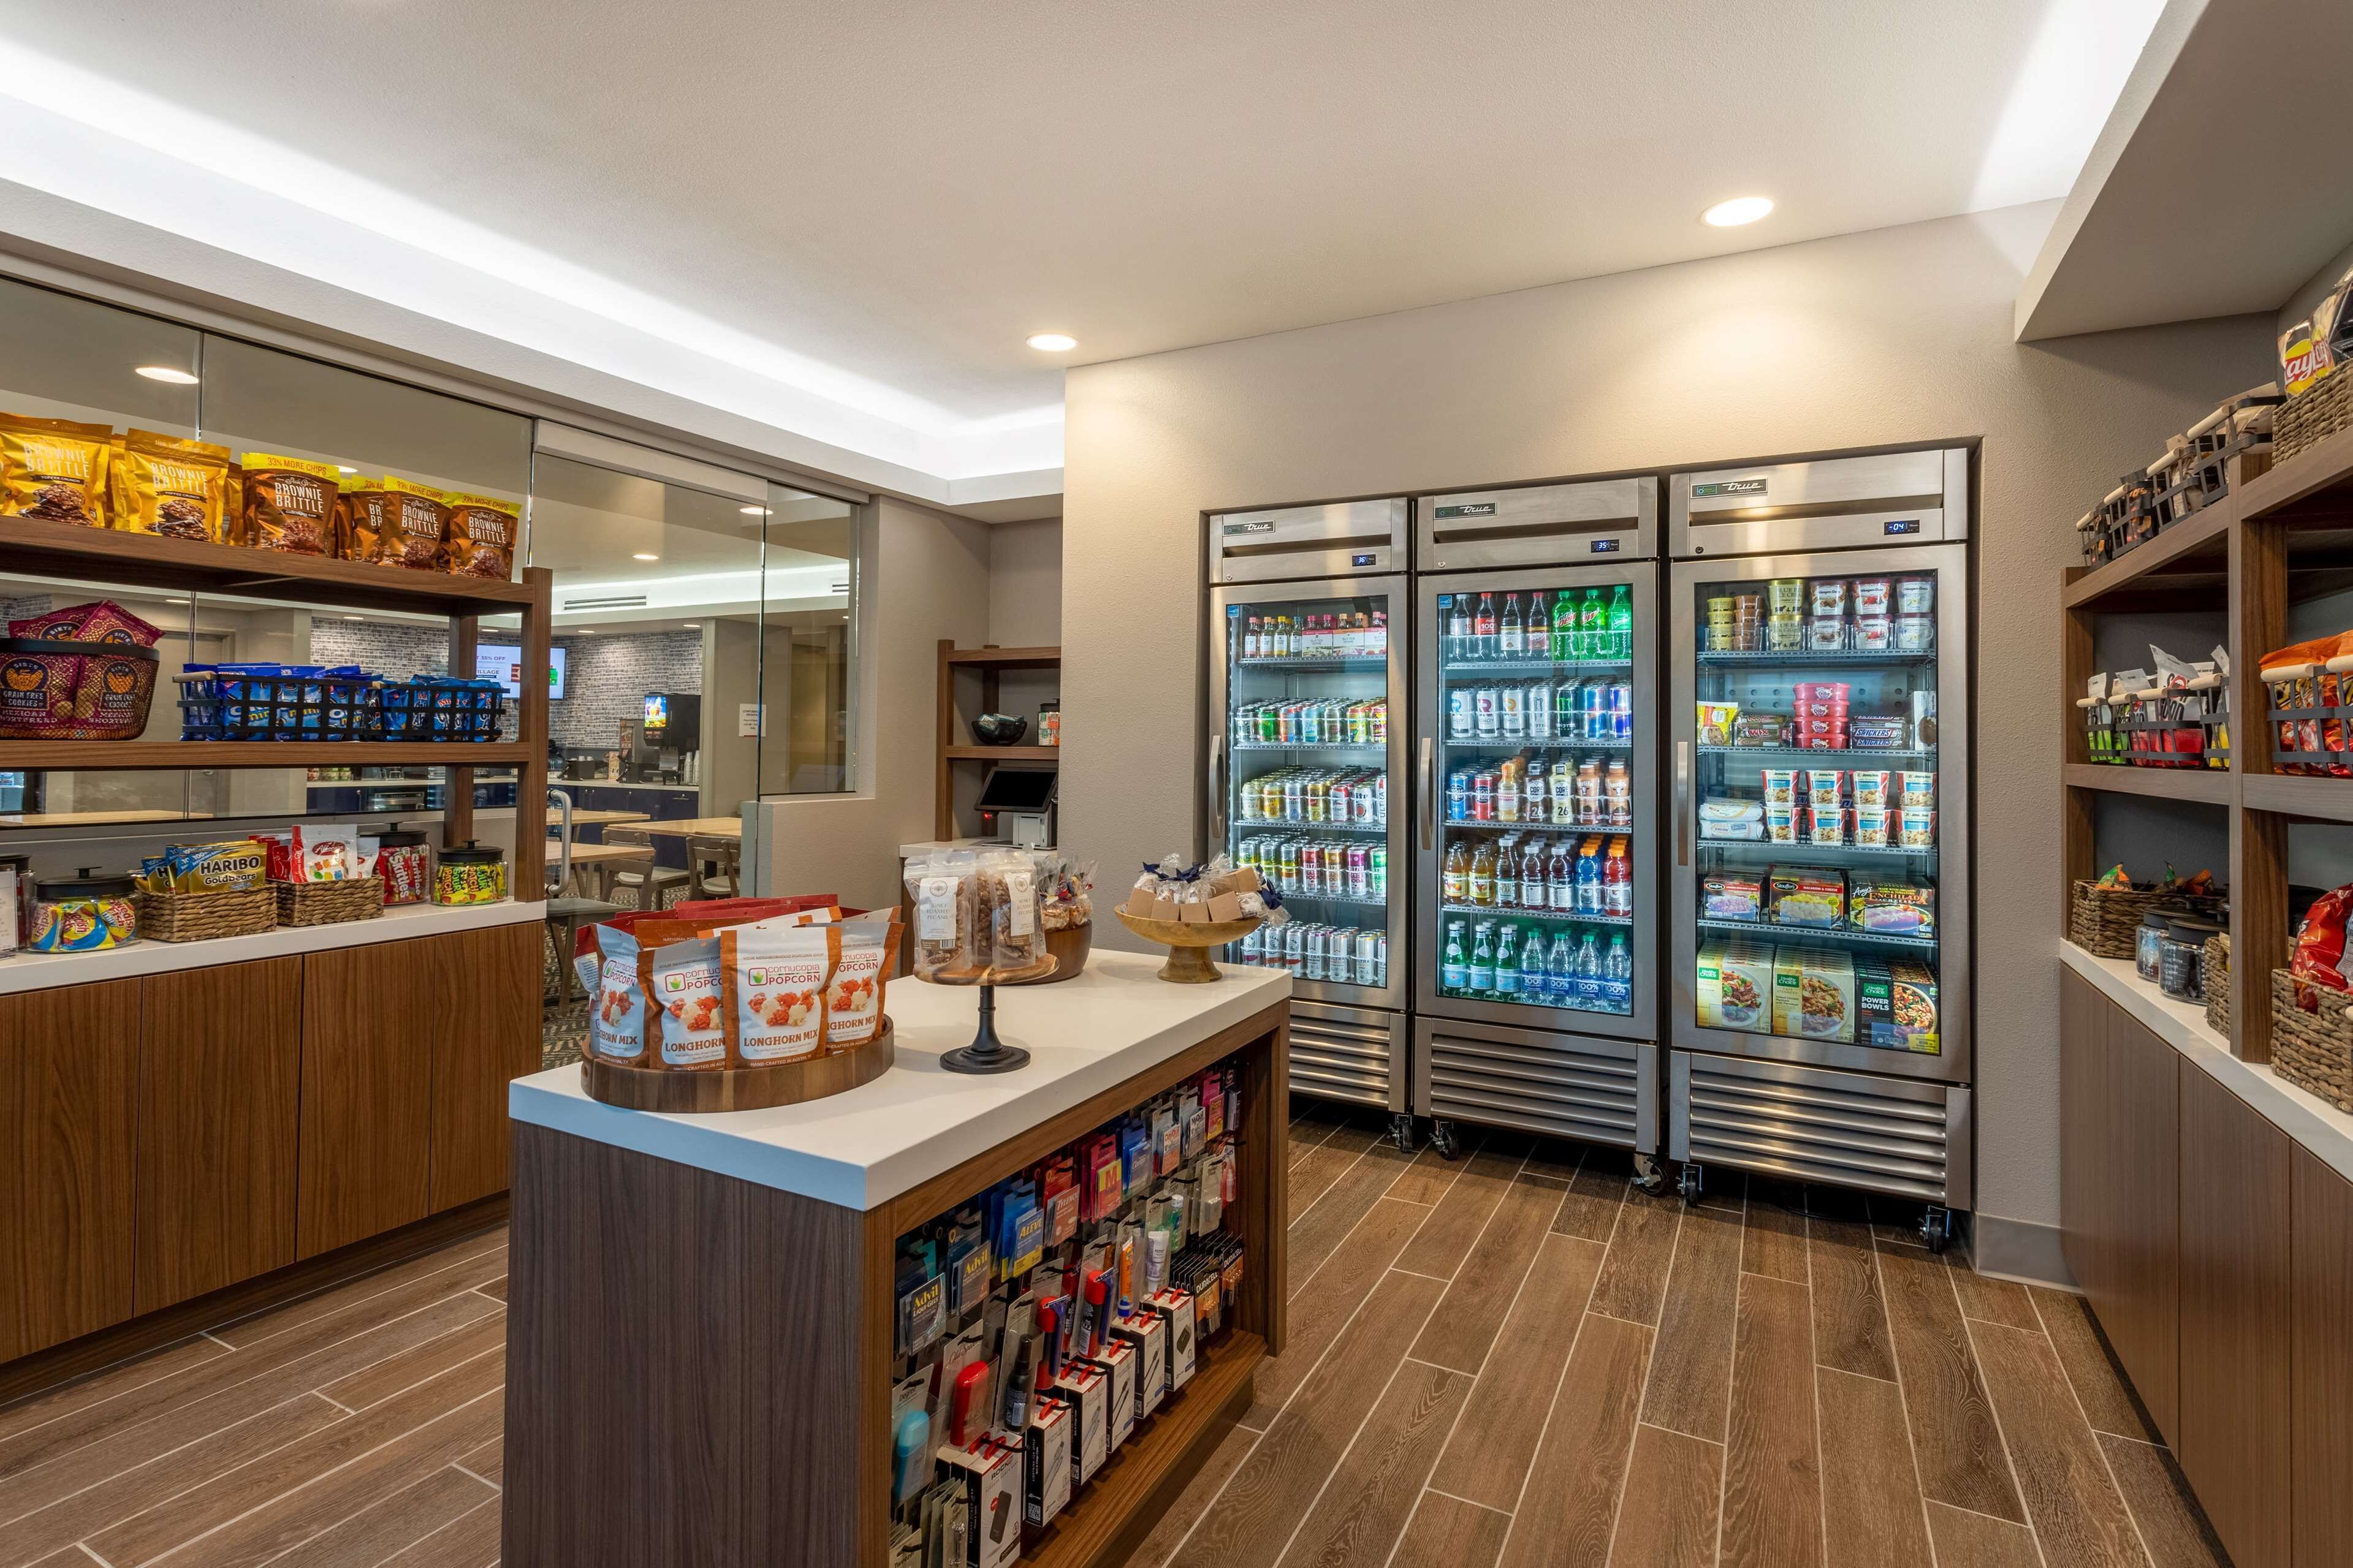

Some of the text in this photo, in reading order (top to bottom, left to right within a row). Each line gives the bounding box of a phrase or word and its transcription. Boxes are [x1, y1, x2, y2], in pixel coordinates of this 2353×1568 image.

[25, 442, 89, 464] BROWNIE
[26, 457, 90, 478] BRITTLE
[151, 462, 207, 482] BROWNIE
[267, 456, 327, 475] 33% MORE CHIPS
[152, 475, 207, 495] BRITTLE
[275, 482, 323, 501] BROWNIE
[409, 484, 425, 494] MORE
[426, 490, 444, 501] CHIPS
[1722, 482, 1762, 491] True
[276, 494, 324, 513] BRITTLE
[474, 497, 492, 506] MORE
[492, 501, 510, 512] CHIPS
[402, 504, 438, 525] BROWNIE
[401, 516, 439, 536] BRITTLE
[468, 517, 506, 534] BROWNIE
[469, 528, 507, 544] BRITTLE
[3, 691, 44, 700] GRAIN FREE
[8, 699, 38, 708] COOKIES
[1855, 729, 1891, 737] SNICKERS
[1532, 806, 1542, 816] 26
[1557, 806, 1569, 816] 26
[199, 856, 260, 874] HARIBO
[204, 872, 257, 885] Goldbears
[389, 854, 409, 898] Skittles
[444, 866, 454, 895] PATCH
[452, 866, 462, 891] SOUR
[469, 866, 479, 892] PATCH
[477, 866, 488, 890] SOUR
[1852, 886, 1873, 898] Amy's
[1869, 892, 1928, 905] ENCHILADA
[108, 906, 124, 928] Fish
[768, 964, 820, 974] cornucopia
[838, 961, 878, 973] OPCORN
[610, 971, 635, 987] POPCORN
[769, 974, 820, 985] POPCORN
[1578, 982, 1599, 991] 100%
[1604, 984, 1626, 993] 100%
[1861, 996, 1889, 1005] POWER
[1861, 1002, 1889, 1011] BOWLS
[865, 1015, 877, 1026] MIX
[618, 1034, 638, 1045] MIX
[665, 1037, 726, 1053] LONGHORN
[743, 1029, 818, 1047] LONGHORN MIX
[1019, 1217, 1043, 1240] ALEVE
[965, 1249, 988, 1274] Advil
[1224, 1248, 1242, 1268] DURACELL
[1196, 1271, 1218, 1294] DURACELL
[914, 1284, 939, 1307] Advil
[913, 1297, 939, 1317] LIQUI-GELS
